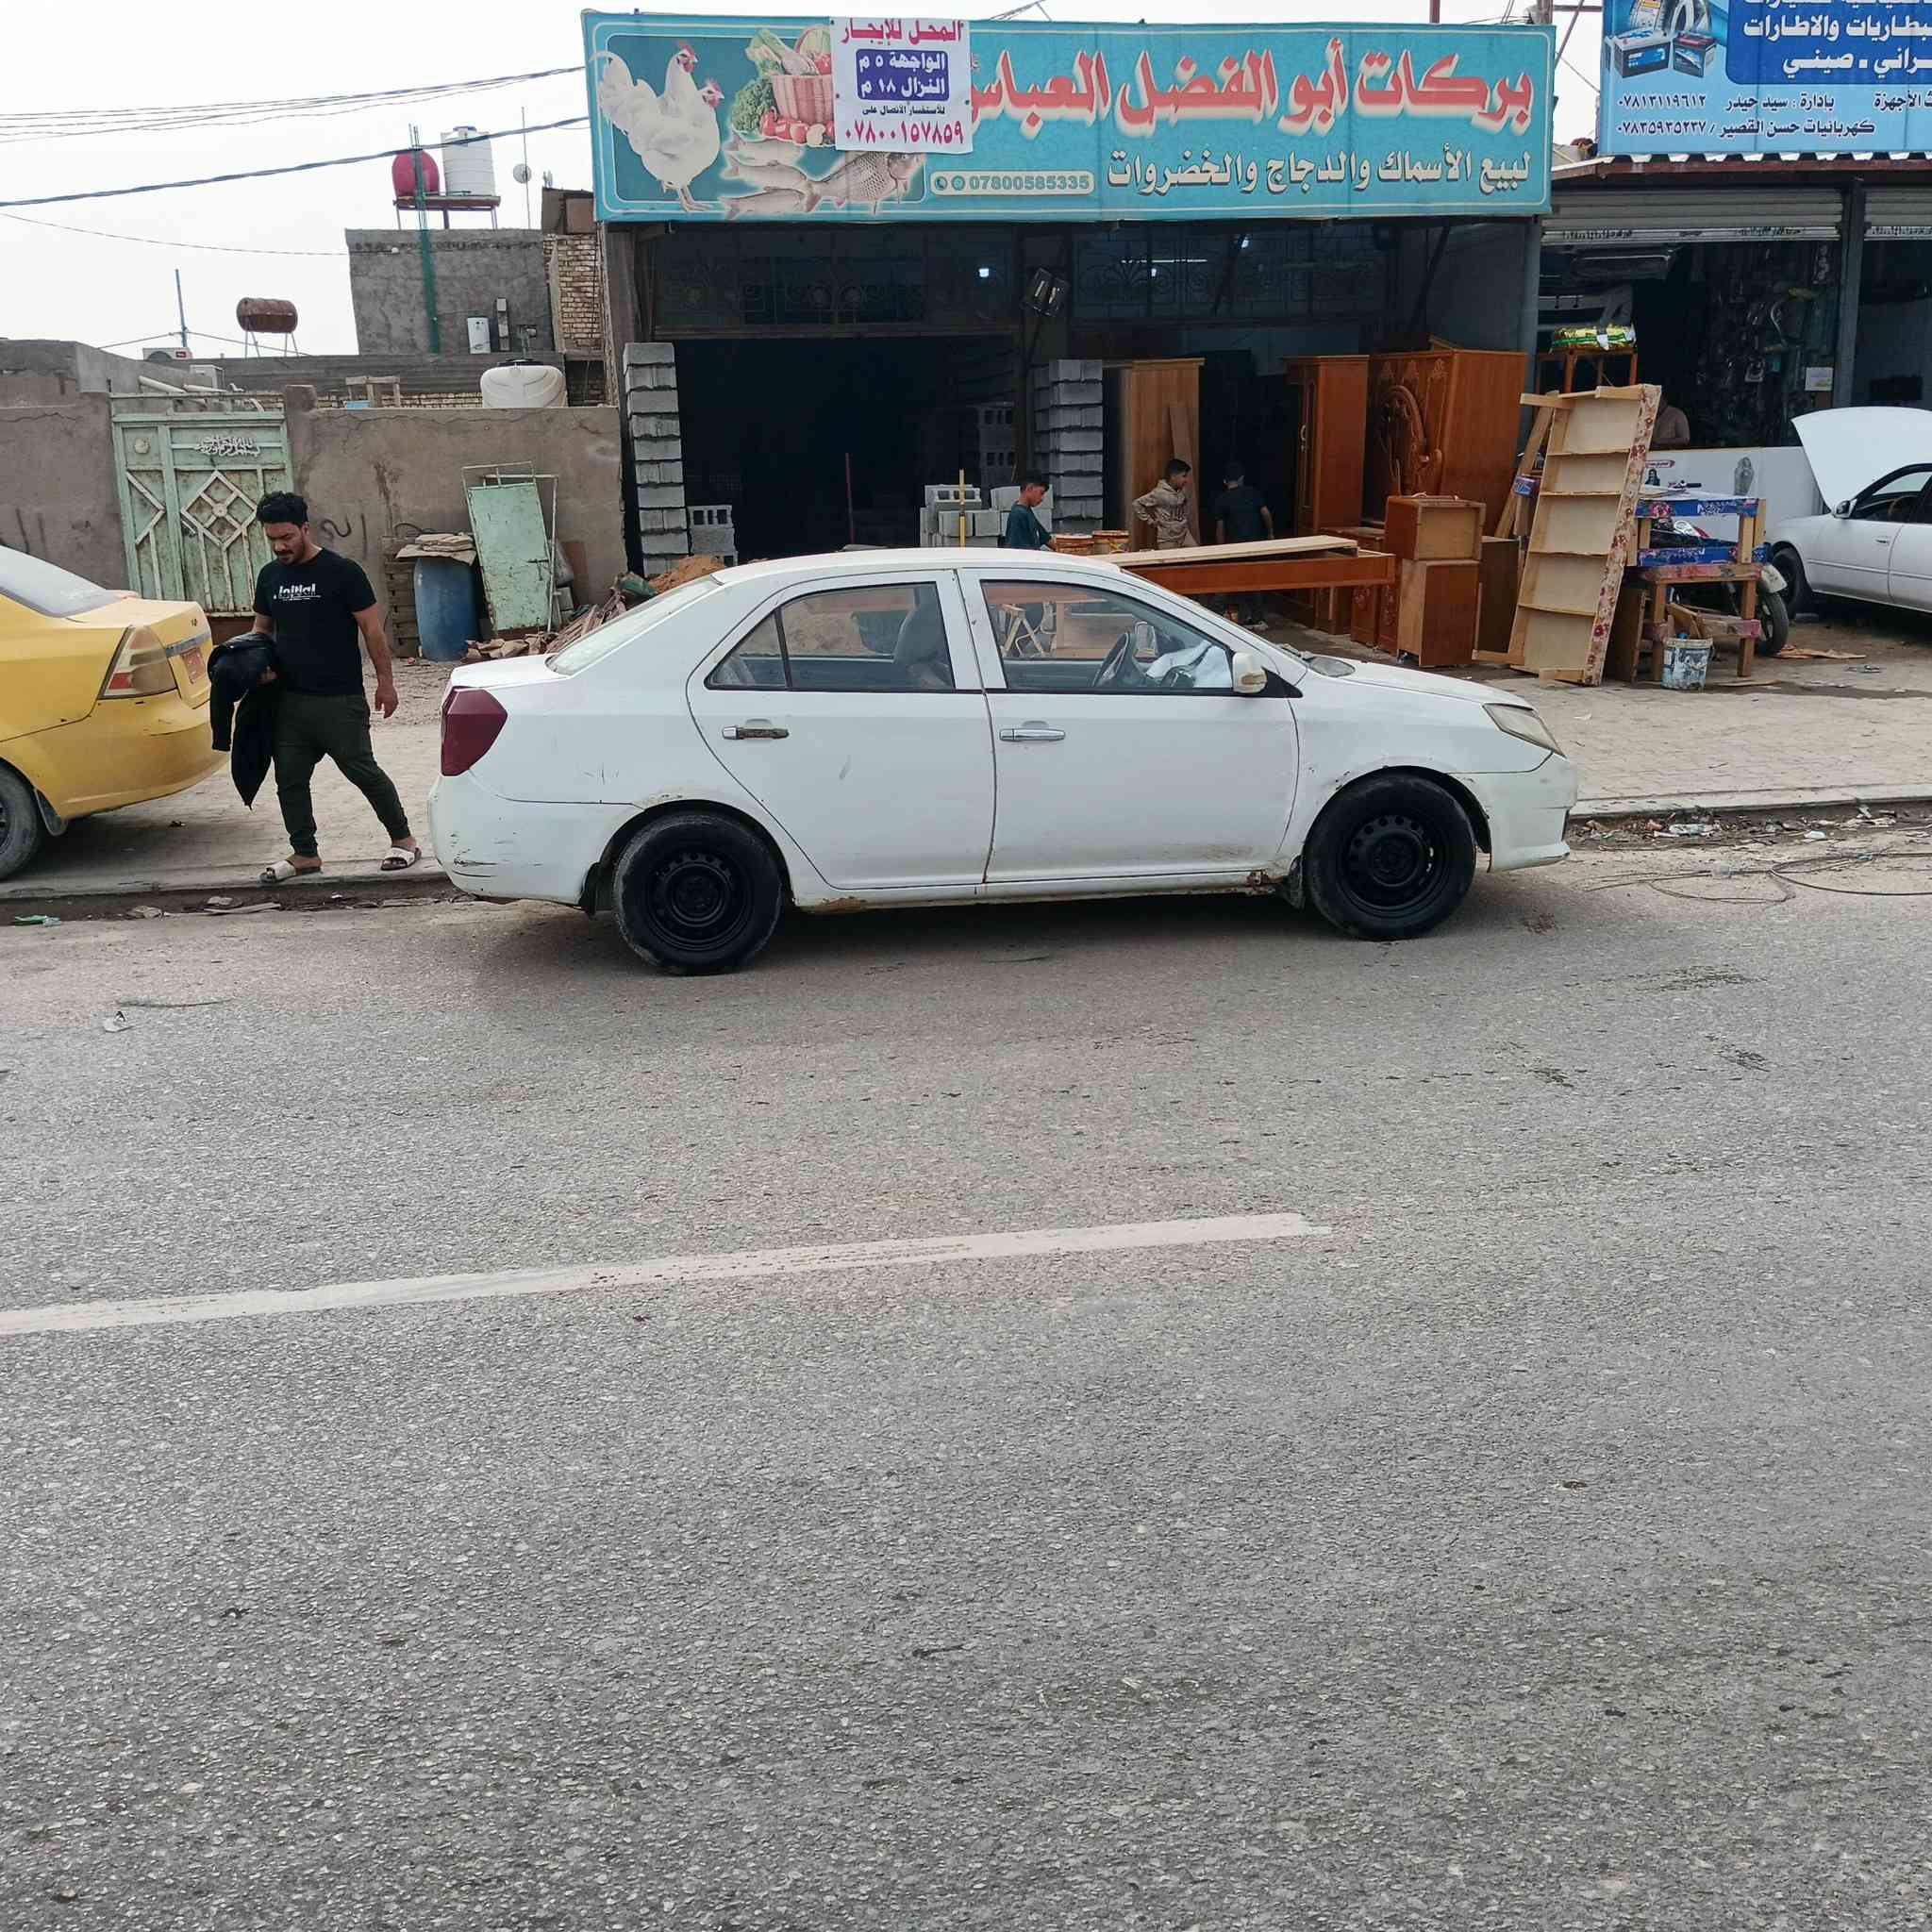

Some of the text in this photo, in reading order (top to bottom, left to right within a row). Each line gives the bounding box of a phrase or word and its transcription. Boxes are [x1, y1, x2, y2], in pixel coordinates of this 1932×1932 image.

[908, 19, 961, 45] المحل
[1743, 14, 1840, 42] والاطارات
[858, 51, 945, 73] الواجهة ٥ م
[1783, 48, 1855, 79] صيني
[860, 80, 872, 98] م
[878, 77, 896, 92] ١٨
[1117, 48, 1278, 137] الفضل
[1279, 37, 1349, 134] أبو
[1355, 48, 1534, 134] بركات
[1725, 94, 1758, 111] حيدر
[1762, 95, 1788, 111] سيد
[845, 120, 964, 144] ٠٧٨٠٠١٥٧٨٥٩
[1720, 119, 1764, 137] القصير
[1767, 120, 1799, 137] حسن
[1108, 142, 1531, 195] لبيع الأسماك والدجاج والخضروات
